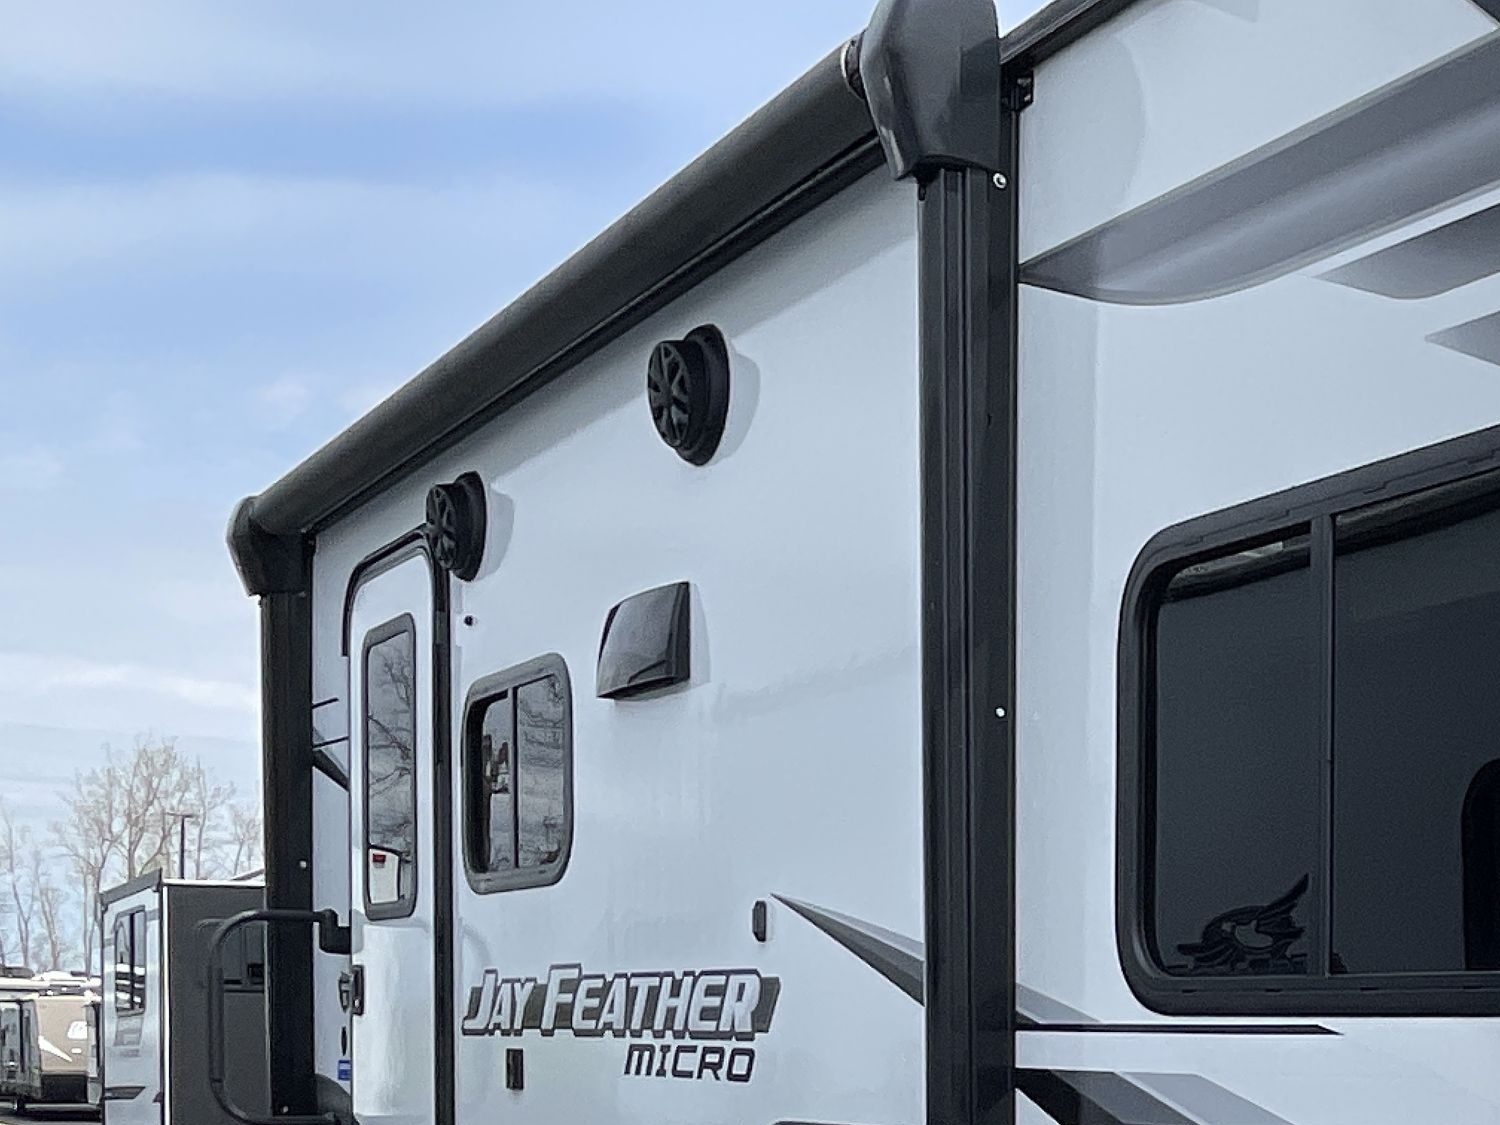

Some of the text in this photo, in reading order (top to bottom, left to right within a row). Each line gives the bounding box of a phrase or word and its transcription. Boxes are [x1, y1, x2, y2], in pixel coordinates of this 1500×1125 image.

[462, 963, 761, 1040] JAY FEATHER
[624, 1043, 755, 1082] MICRO
